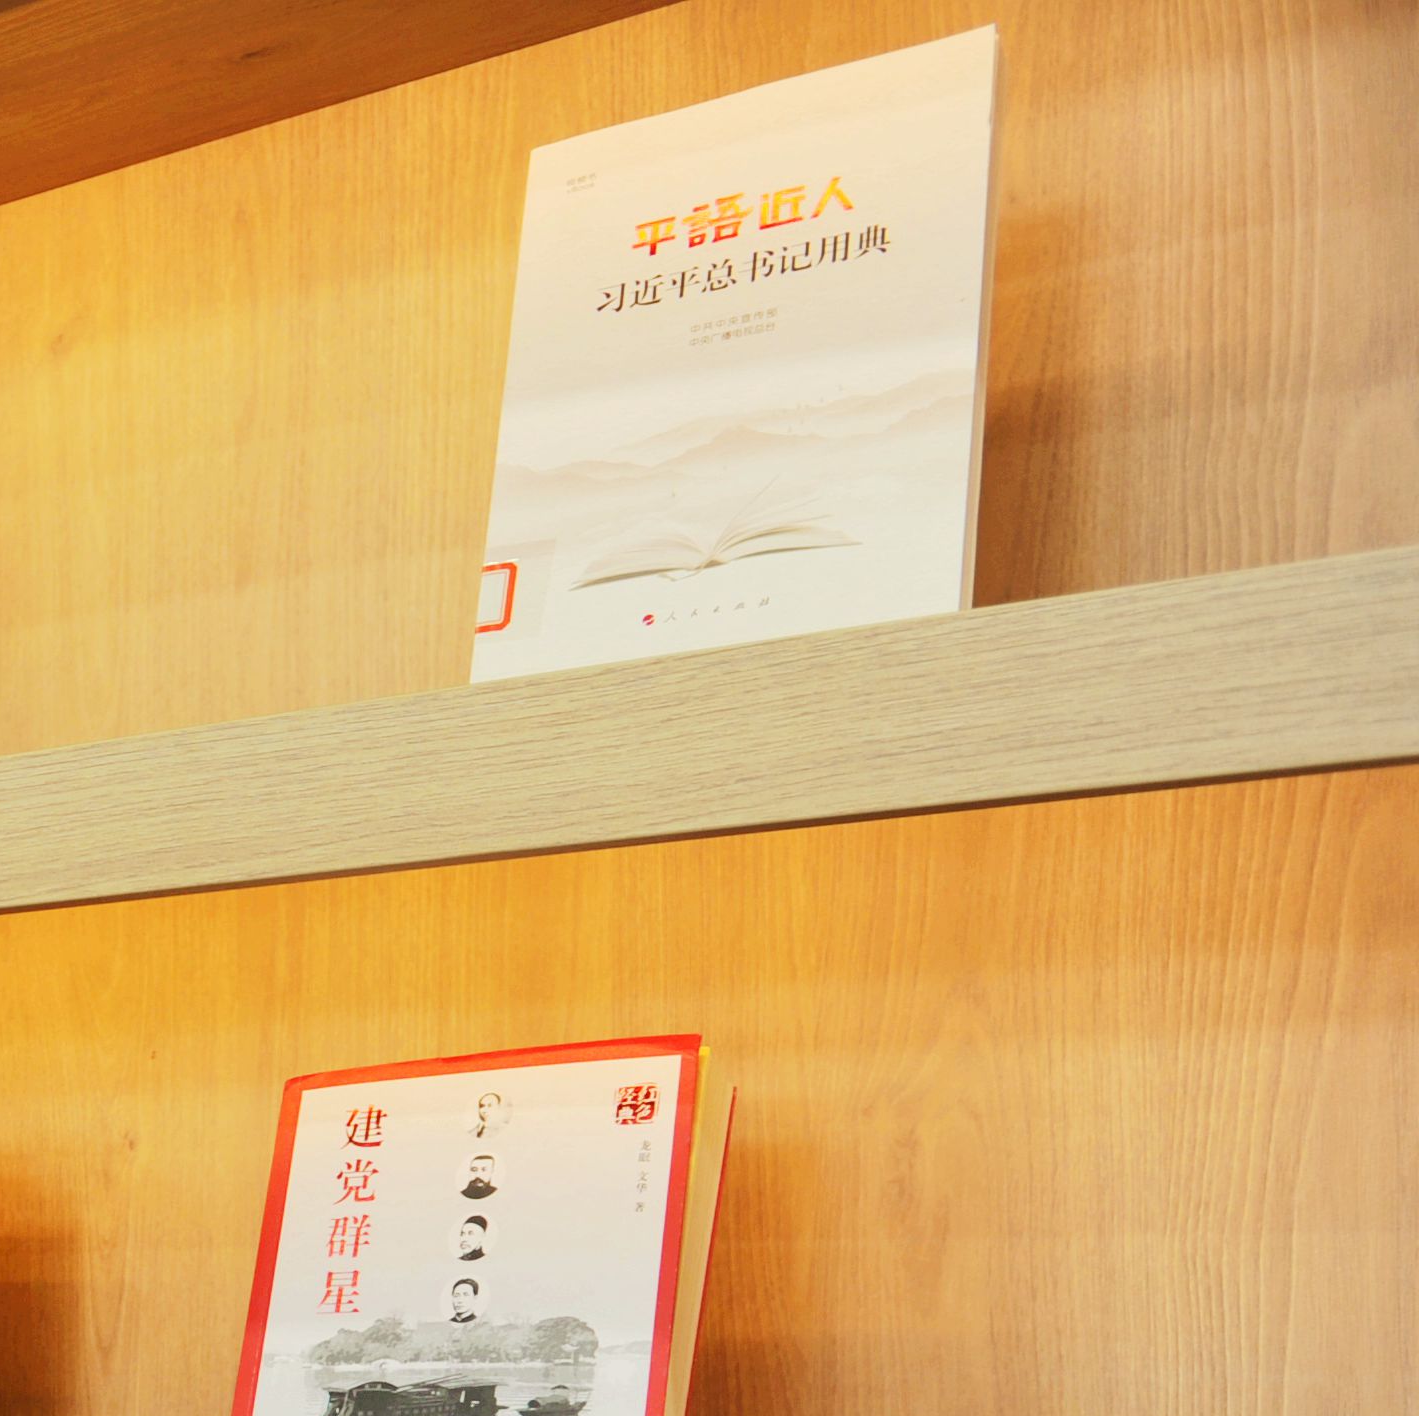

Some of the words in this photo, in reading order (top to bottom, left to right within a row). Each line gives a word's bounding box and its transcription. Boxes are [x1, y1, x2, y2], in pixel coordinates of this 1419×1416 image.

[631, 176, 855, 258] 平語近人
[594, 222, 892, 315] 习近平总书记用典
[315, 1102, 389, 1316] 建党群星
